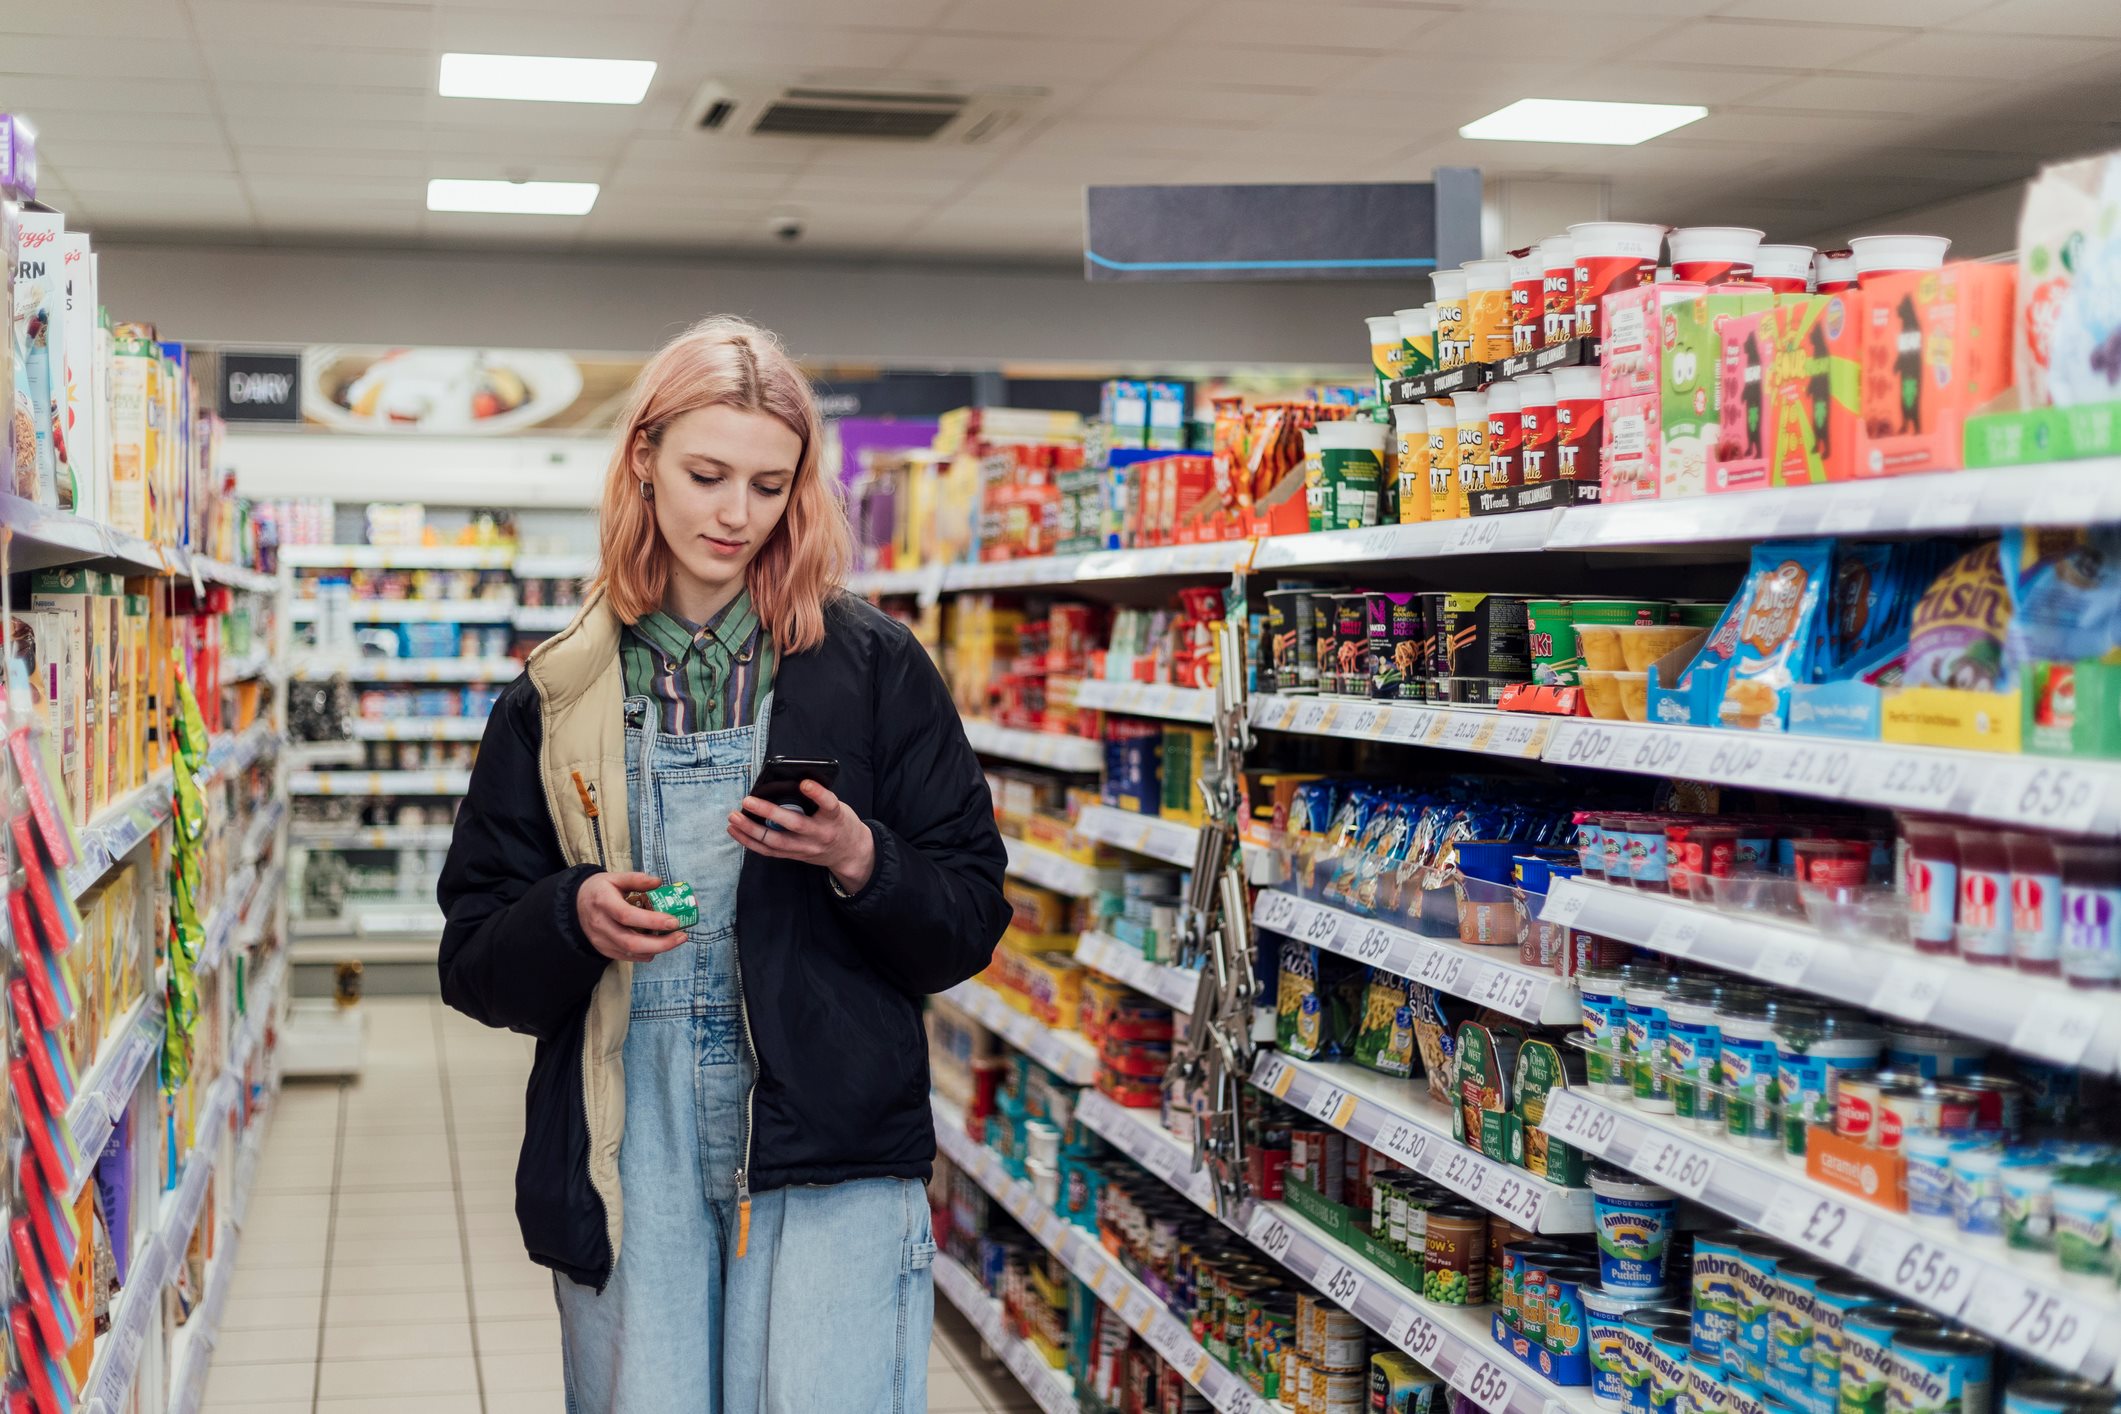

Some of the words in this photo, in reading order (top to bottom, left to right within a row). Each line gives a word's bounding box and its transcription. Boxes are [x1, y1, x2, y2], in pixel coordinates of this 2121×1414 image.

[18, 224, 55, 248] ogg's
[15, 261, 46, 279] RN
[1544, 277, 1568, 292] ING
[1511, 290, 1528, 304] NG
[1438, 305, 1462, 321] ING
[1544, 313, 1576, 336] OT
[1513, 324, 1536, 345] OT
[1439, 340, 1470, 360] OT
[1489, 421, 1504, 435] NG
[1521, 414, 1537, 429] NG
[1429, 435, 1444, 449] NG
[1458, 430, 1482, 445] ING
[1490, 456, 1512, 477] OT
[1522, 451, 1545, 471] OT
[1557, 446, 1579, 467] OT
[1429, 468, 1452, 488] OT
[1459, 464, 1490, 485] OT
[1480, 493, 1495, 512] POT
[1746, 614, 1791, 648] Delight
[1408, 711, 1434, 740] £1
[1454, 722, 1480, 740] £1.30
[1567, 726, 1612, 763] 60p
[1633, 731, 1681, 768] 60p
[1708, 741, 1760, 779] 60p
[1781, 751, 1849, 789] £1.10
[1882, 761, 1959, 797] £2.30
[2016, 764, 2096, 820] 65p
[1307, 910, 1337, 941] 85p
[1357, 927, 1391, 960] 85p
[1420, 951, 1463, 985] £1.15
[1486, 971, 1533, 1009] £1.15
[1583, 1009, 1604, 1028] rosia
[1465, 1035, 1480, 1050] JOHN
[1670, 1038, 1692, 1059] rosia
[1467, 1048, 1482, 1062] WEST
[1529, 1053, 1546, 1068] JOHN
[1722, 1052, 1747, 1075] rosia
[1261, 1060, 1280, 1089] £1
[1532, 1066, 1549, 1081] WEST
[1318, 1088, 1339, 1120] £1
[1839, 1105, 1871, 1123] ation
[1565, 1103, 1616, 1143] £1.60
[1388, 1125, 1426, 1159] £2.30
[1445, 1152, 1488, 1193] £2.75
[1653, 1143, 1710, 1188] £1.60
[1495, 1178, 1542, 1220] £2.75
[1603, 1211, 1660, 1234] Ambrosia
[1801, 1200, 1848, 1250] £2
[1261, 1221, 1289, 1257] 40p
[1611, 1269, 1652, 1283] Pudding
[1619, 1260, 1642, 1273] Rice
[1694, 1254, 1740, 1277] mbro
[1895, 1241, 1961, 1300] 65p
[1327, 1266, 1358, 1300] 45p
[1739, 1266, 1777, 1301] rosia
[2007, 1287, 2079, 1349] 75p
[1402, 1315, 1439, 1359] 65p
[1591, 1326, 1624, 1344] Ambro
[1622, 1331, 1654, 1363] rosi
[1842, 1337, 1892, 1376] rosia
[1605, 1373, 1621, 1385] Ric
[1651, 1353, 1685, 1385] rosia
[1890, 1359, 1944, 1401] rosia
[1469, 1361, 1508, 1407] 65p
[1689, 1371, 1728, 1406] rosia
